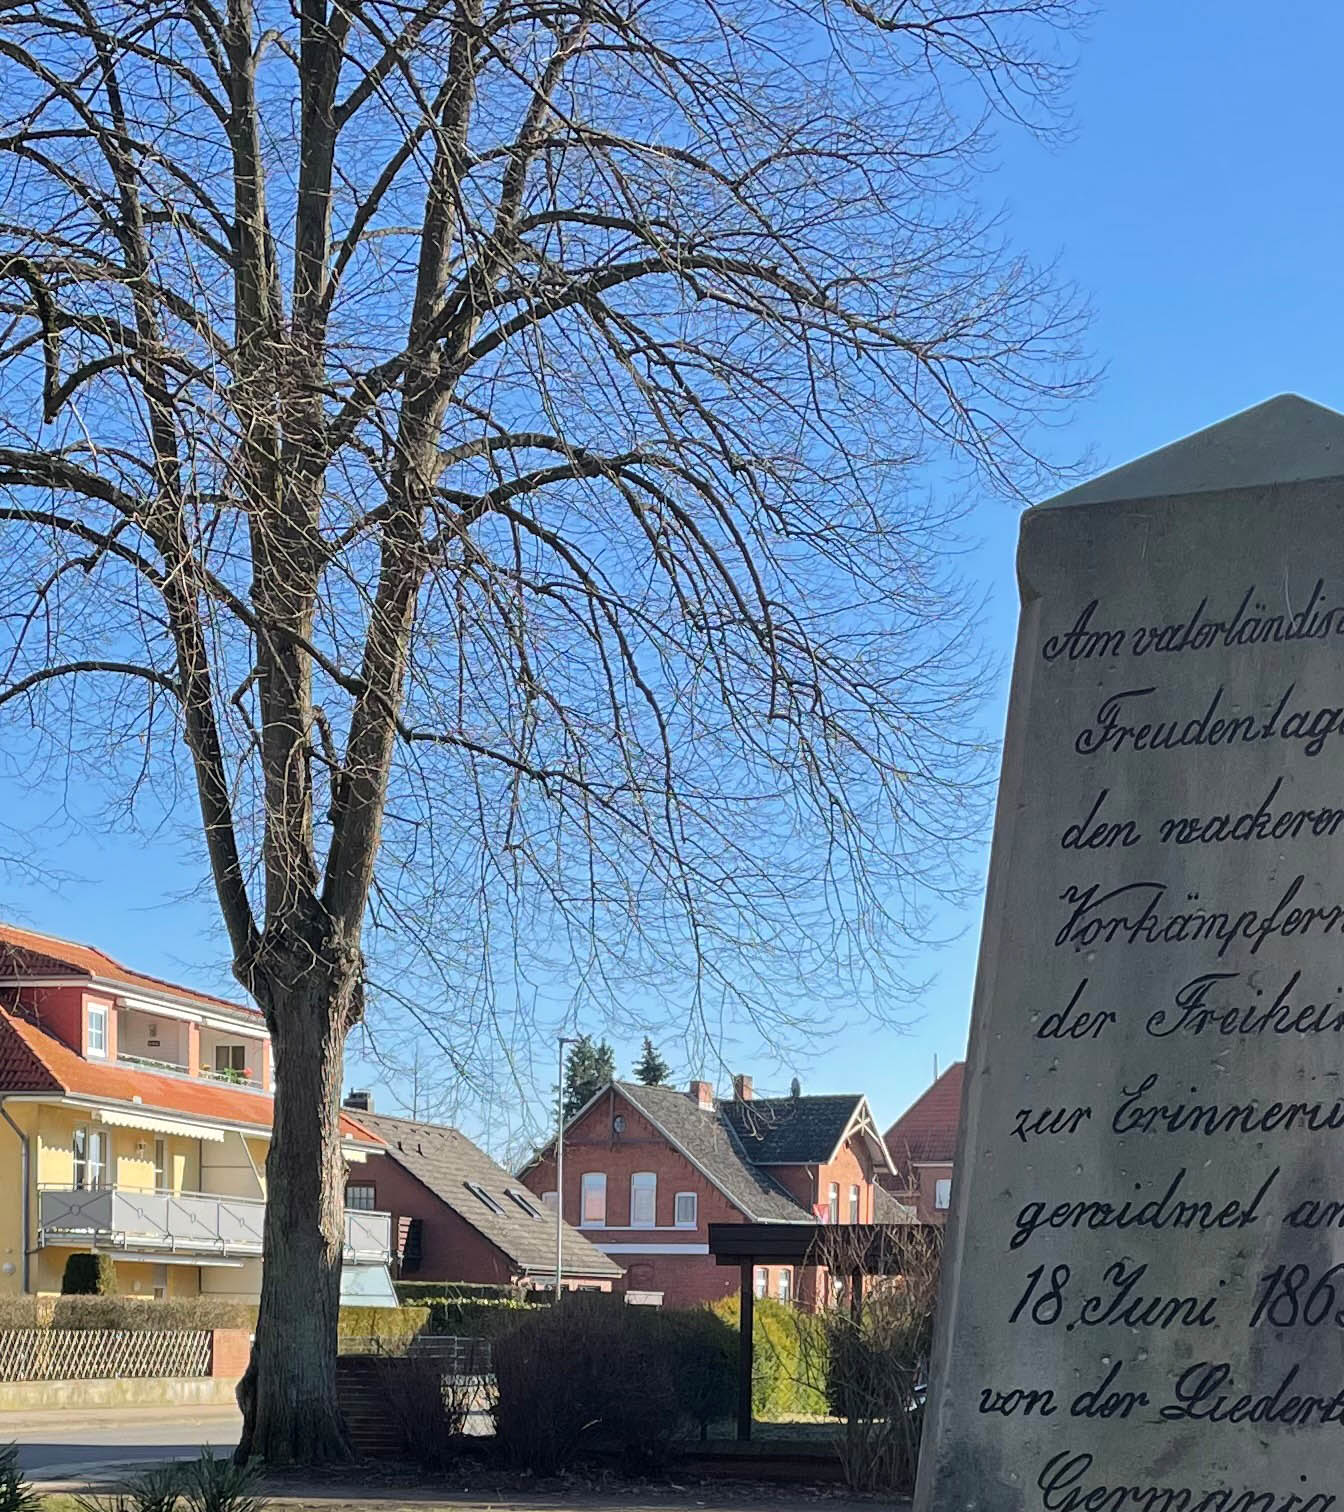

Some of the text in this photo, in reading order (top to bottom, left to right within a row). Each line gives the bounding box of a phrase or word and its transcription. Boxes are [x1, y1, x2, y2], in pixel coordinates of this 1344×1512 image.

[1043, 600, 1122, 661] Am
[1062, 789, 1141, 851] den
[1035, 978, 1117, 1041] der
[1010, 1104, 1094, 1143] zur
[1011, 1166, 1282, 1251] gewidmet
[979, 1383, 1059, 1417] von
[1070, 1362, 1150, 1420] der
